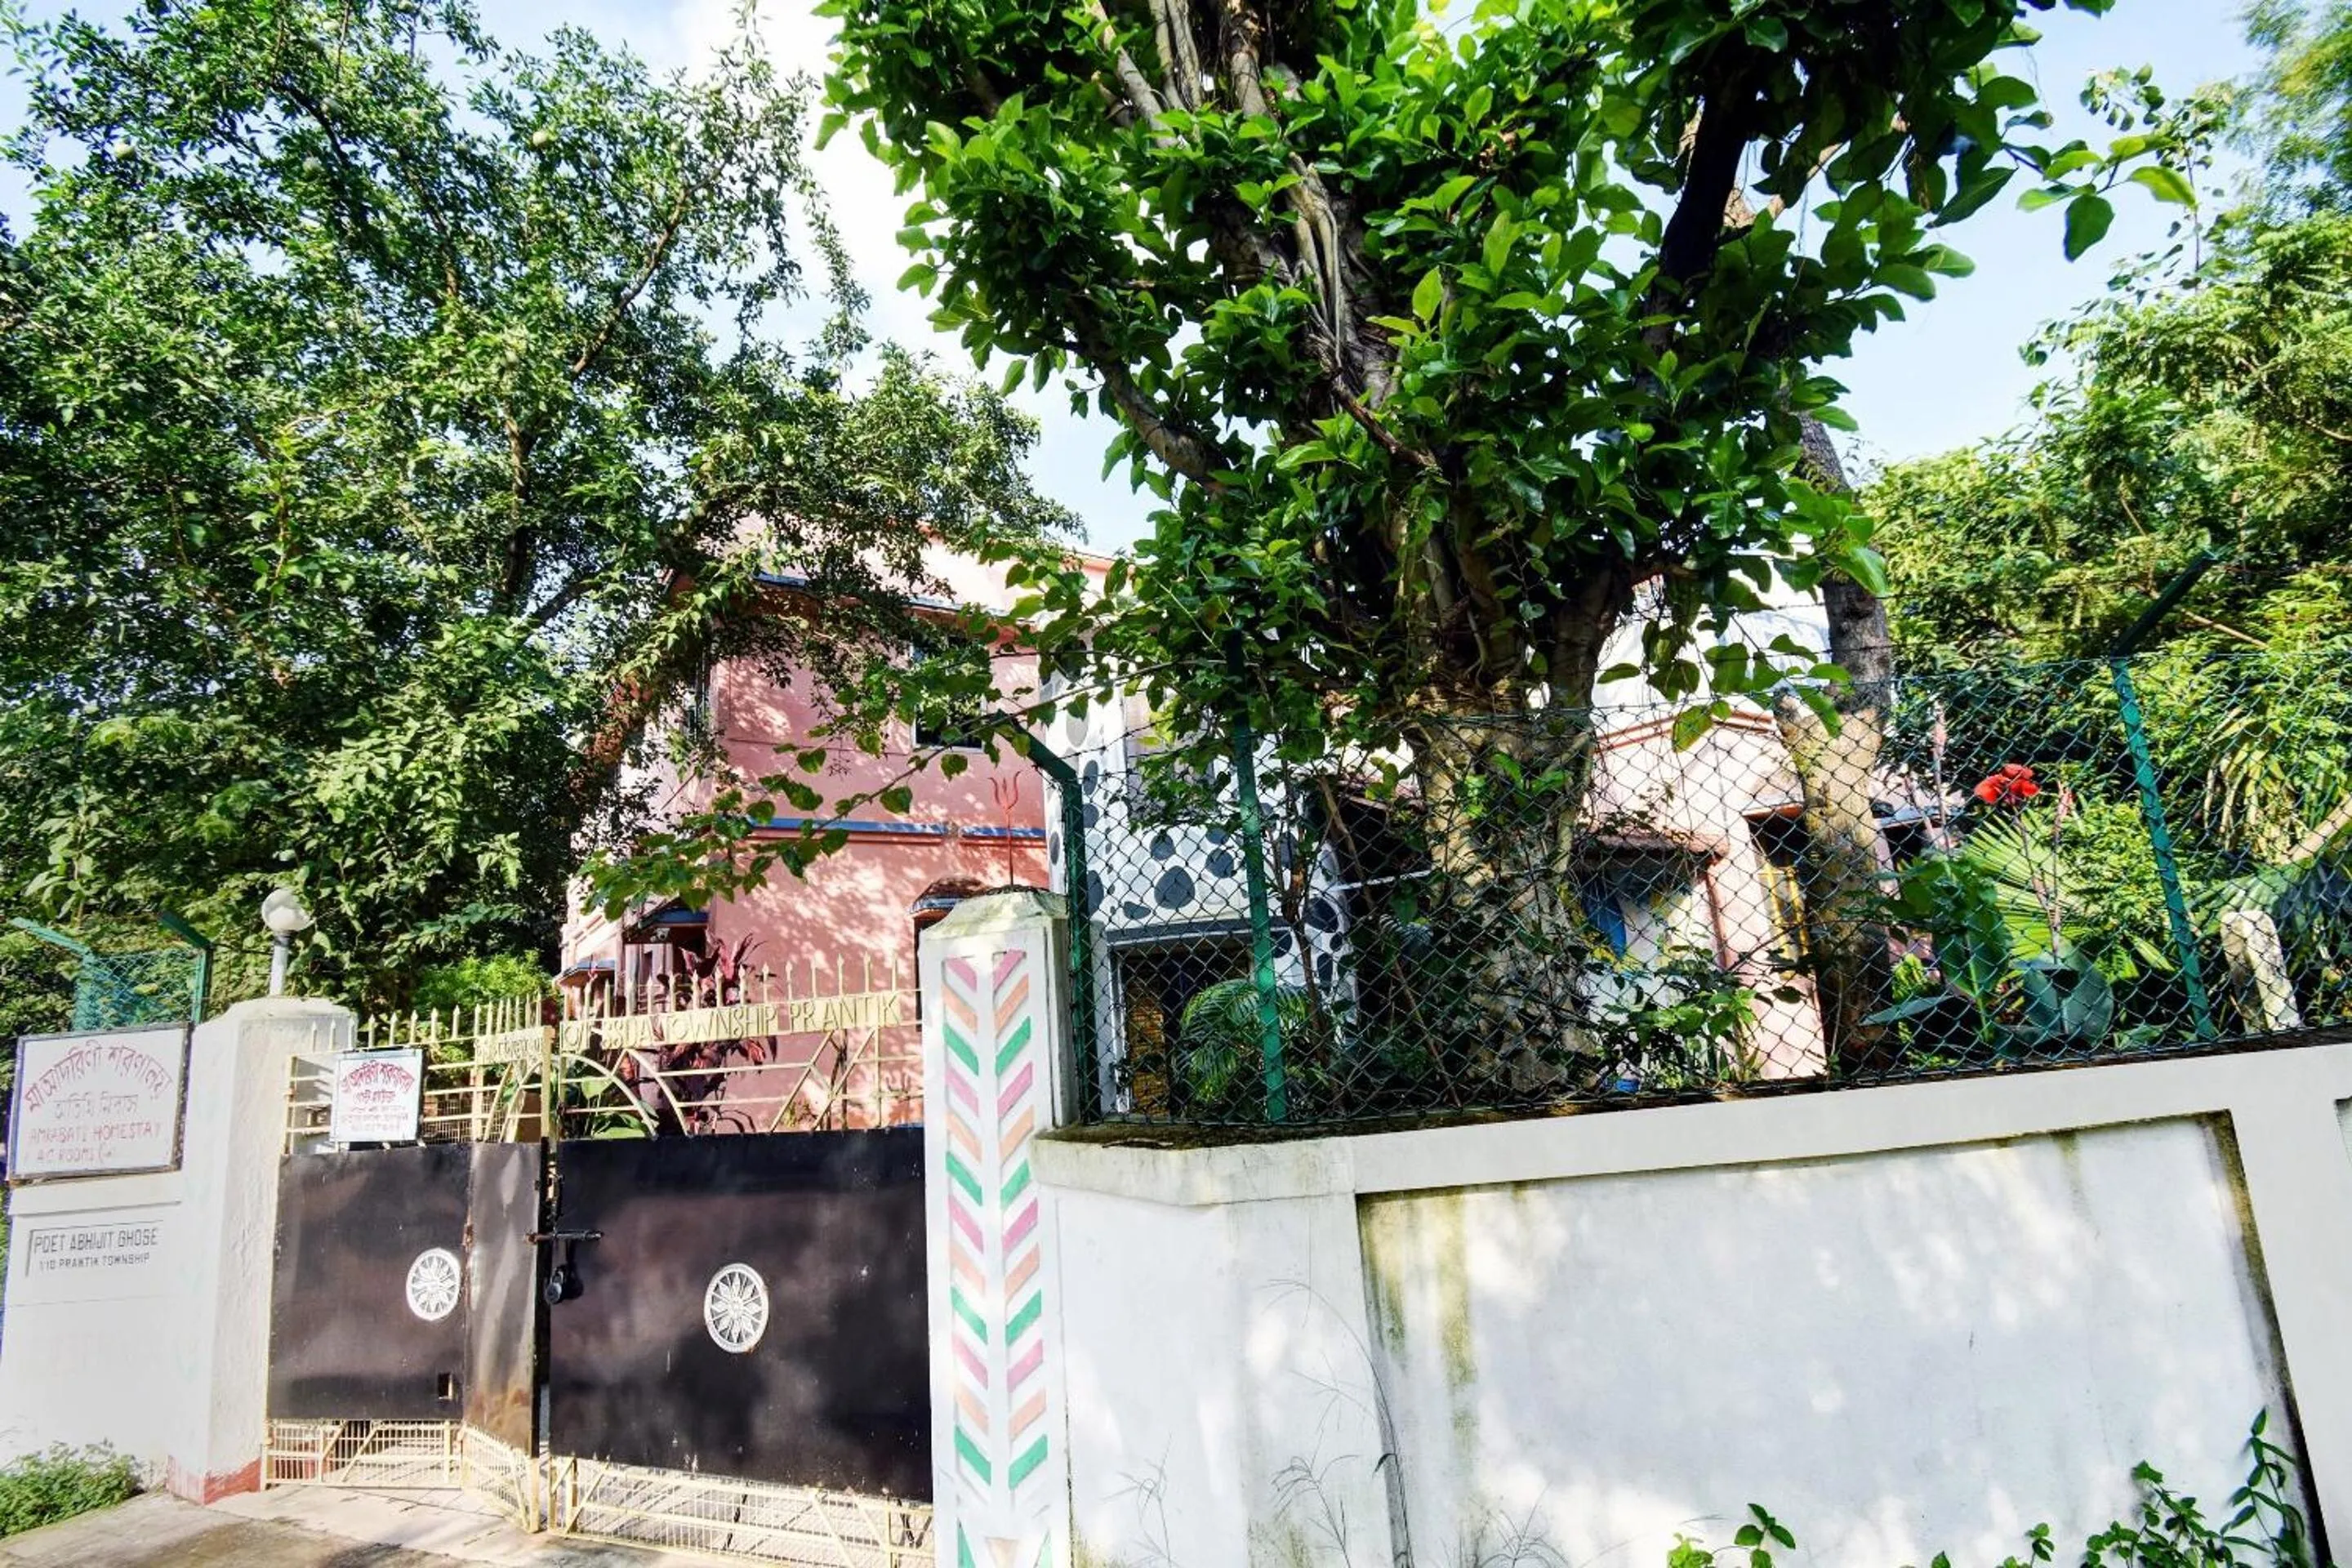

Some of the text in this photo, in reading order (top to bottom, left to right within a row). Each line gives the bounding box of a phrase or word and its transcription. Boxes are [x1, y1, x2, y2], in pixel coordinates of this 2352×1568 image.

[665, 1004, 777, 1045] TOWNSHIP
[789, 991, 900, 1036] PRANTIK
[34, 1234, 65, 1254] POET
[118, 1227, 158, 1247] GHOSE
[102, 1253, 150, 1266] TOWNSHIP
